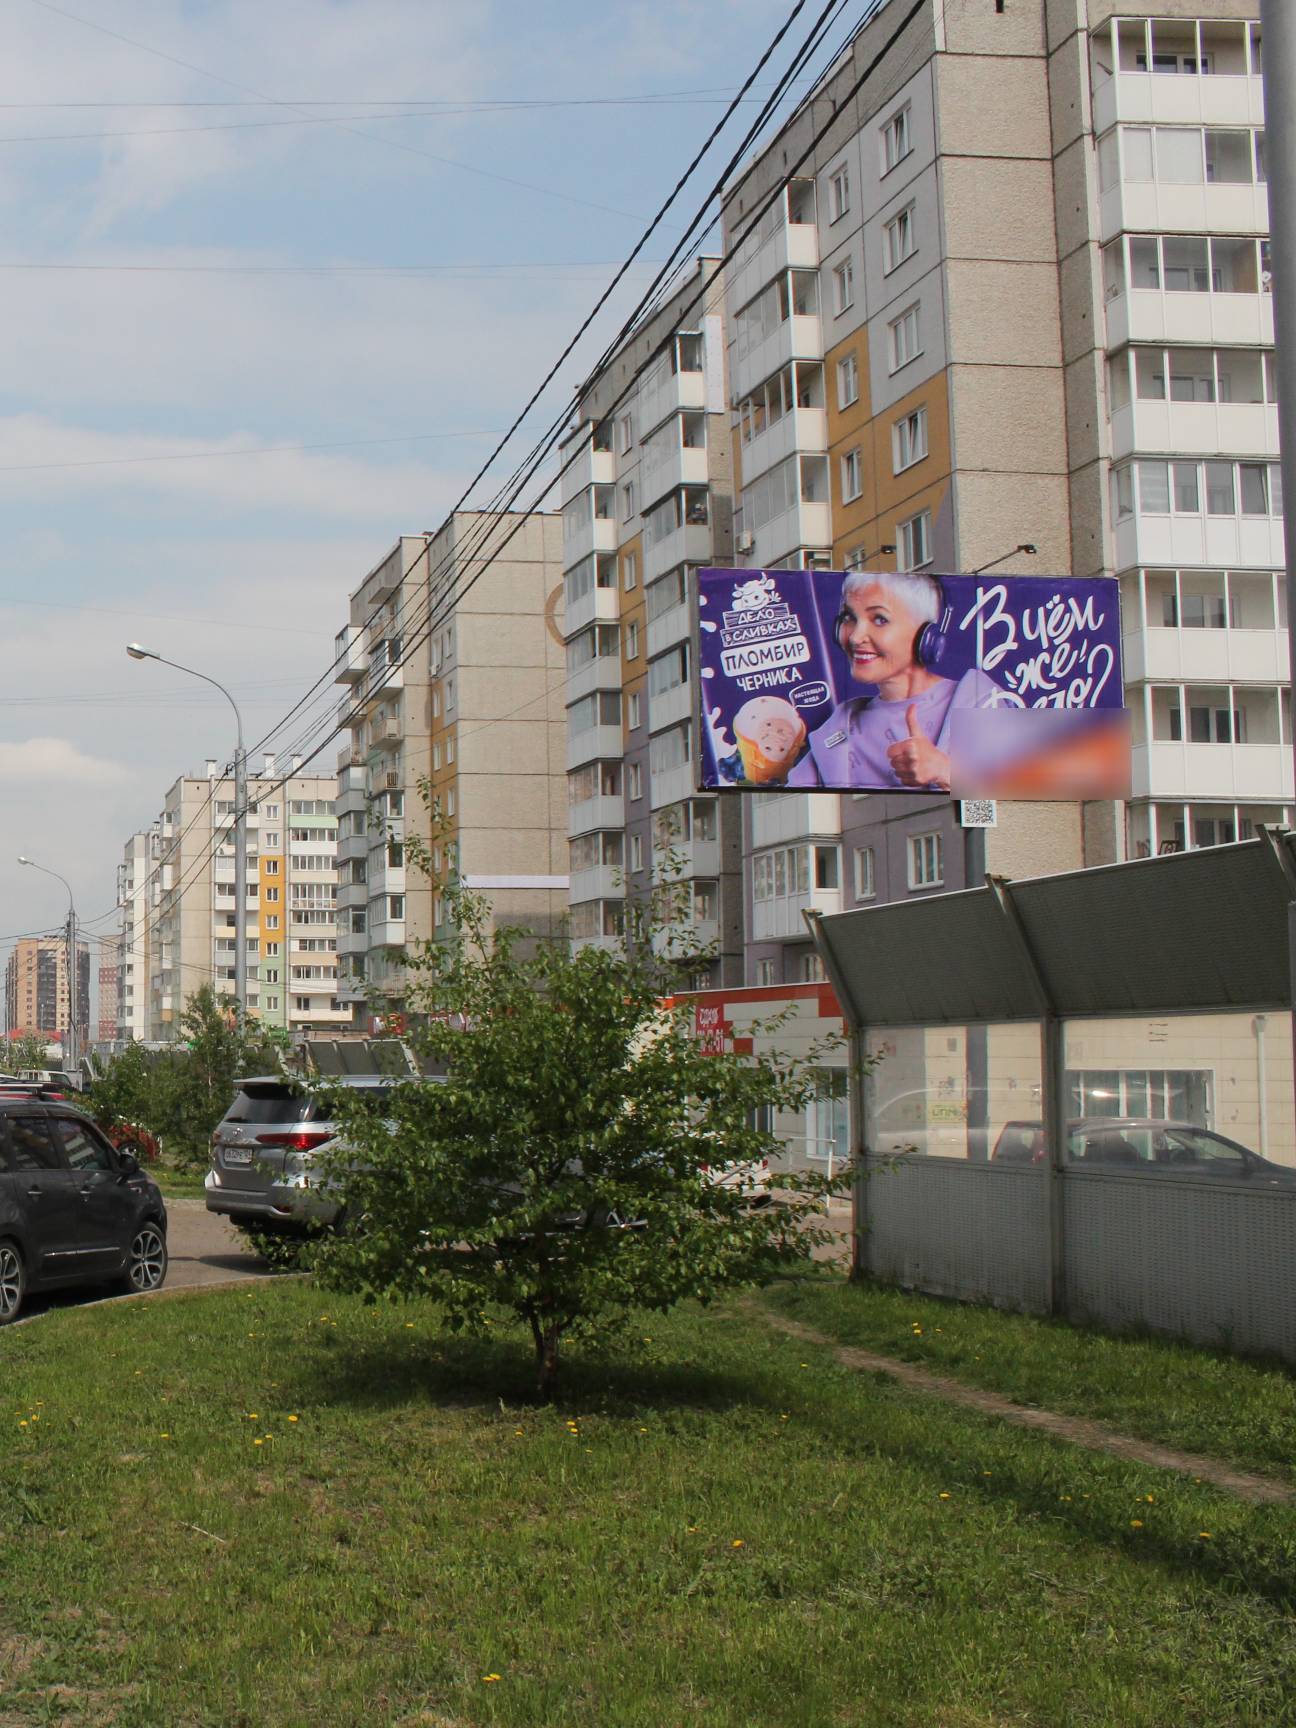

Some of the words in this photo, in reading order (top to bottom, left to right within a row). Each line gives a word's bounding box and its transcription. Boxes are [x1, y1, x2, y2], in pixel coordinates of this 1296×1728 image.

[732, 619, 796, 641] СЛИВКАХ
[738, 609, 775, 624] ДЕЛО
[960, 585, 1018, 670] В
[1023, 594, 1105, 649] чём
[725, 642, 805, 671] ПЛОМБИР
[1015, 642, 1079, 695] же
[736, 666, 803, 692] ЧЕРНИКА
